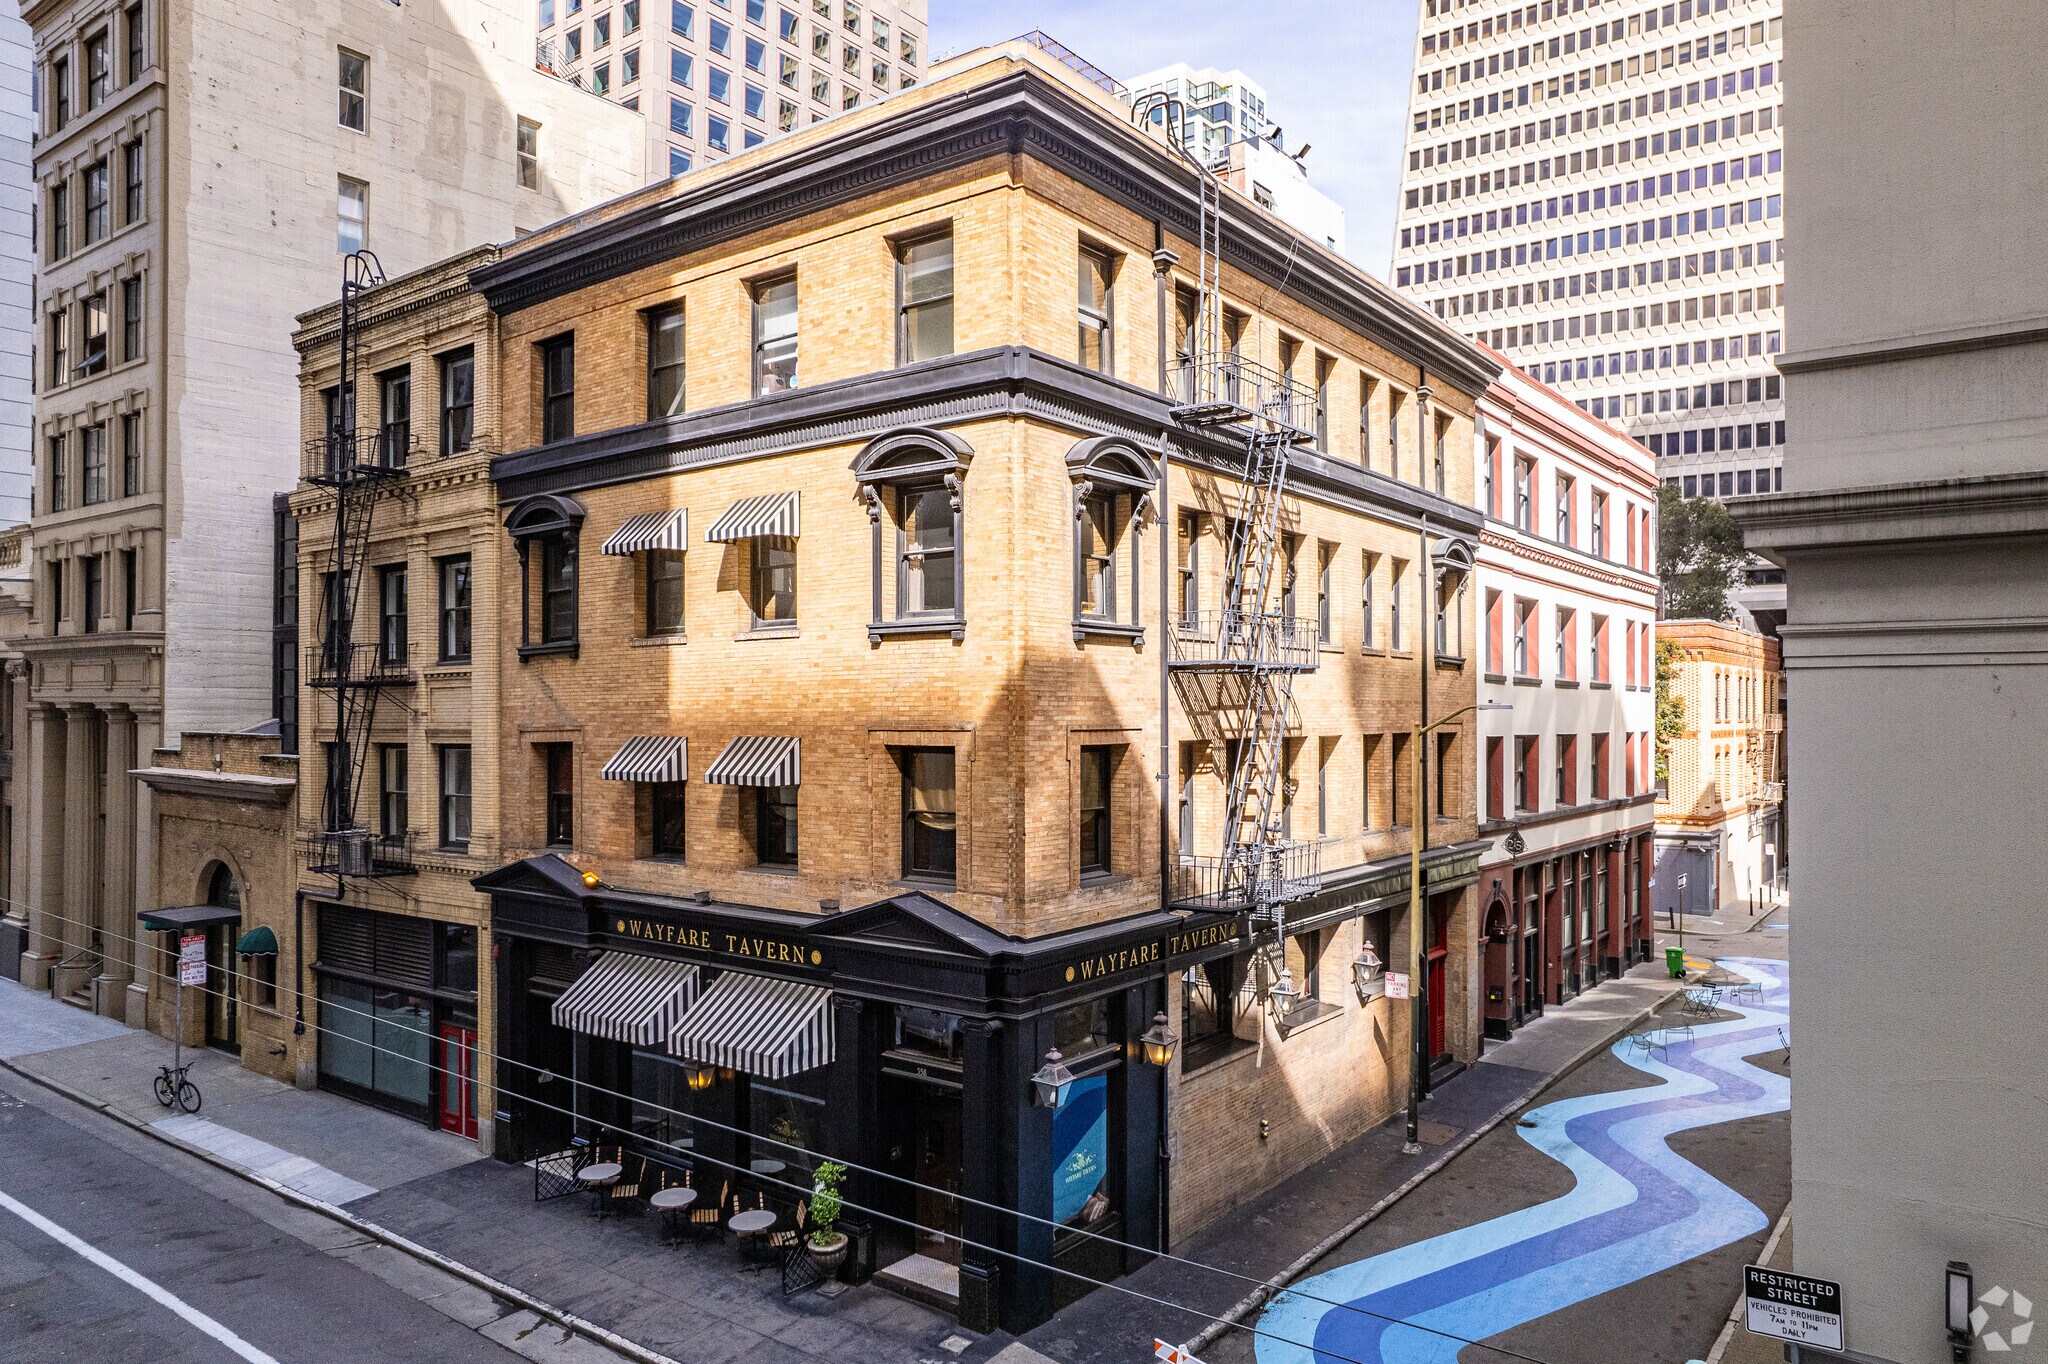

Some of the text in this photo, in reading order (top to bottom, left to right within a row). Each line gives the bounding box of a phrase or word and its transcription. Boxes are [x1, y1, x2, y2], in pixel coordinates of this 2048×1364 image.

[629, 919, 805, 964] WAYFARE TAVERN
[1081, 923, 1228, 980] WAYFARE TAVERN
[1750, 1271, 1835, 1297] RESTRICTED
[1767, 1287, 1818, 1306] STREET
[1750, 1301, 1838, 1326] VEHICLES PROHIBITED
[1769, 1314, 1786, 1325] 7AM
[1801, 1320, 1819, 1332] 11PM
[1782, 1326, 1807, 1339] DAILY
